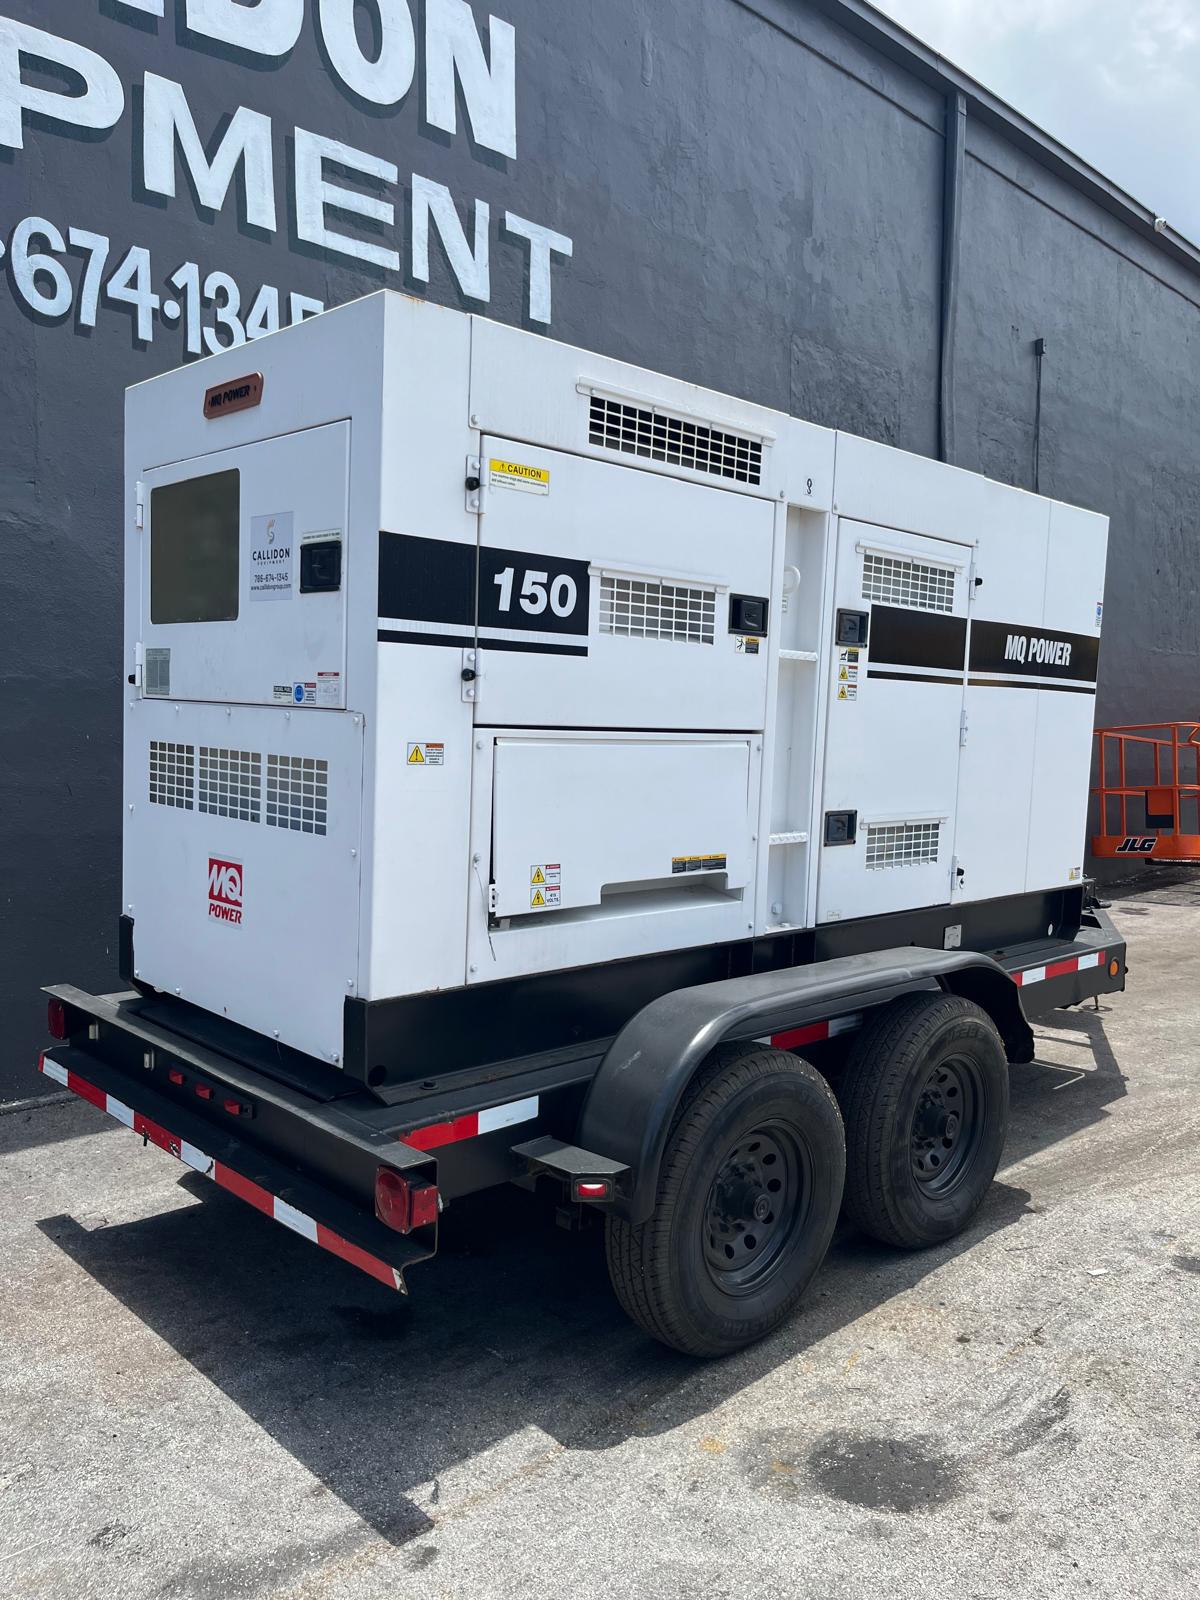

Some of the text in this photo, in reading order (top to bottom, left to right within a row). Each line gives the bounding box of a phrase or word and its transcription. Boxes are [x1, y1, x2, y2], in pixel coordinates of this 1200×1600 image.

[222, 384, 250, 404] POWER
[507, 464, 542, 479] CAUTION
[252, 547, 290, 561] CALLIDON
[254, 572, 289, 583] 786-674-1345
[493, 567, 578, 618] 150
[1004, 634, 1072, 666] MQ POWER
[1115, 837, 1158, 853] JLG
[208, 864, 242, 902] MQ
[209, 903, 242, 924] POWER
